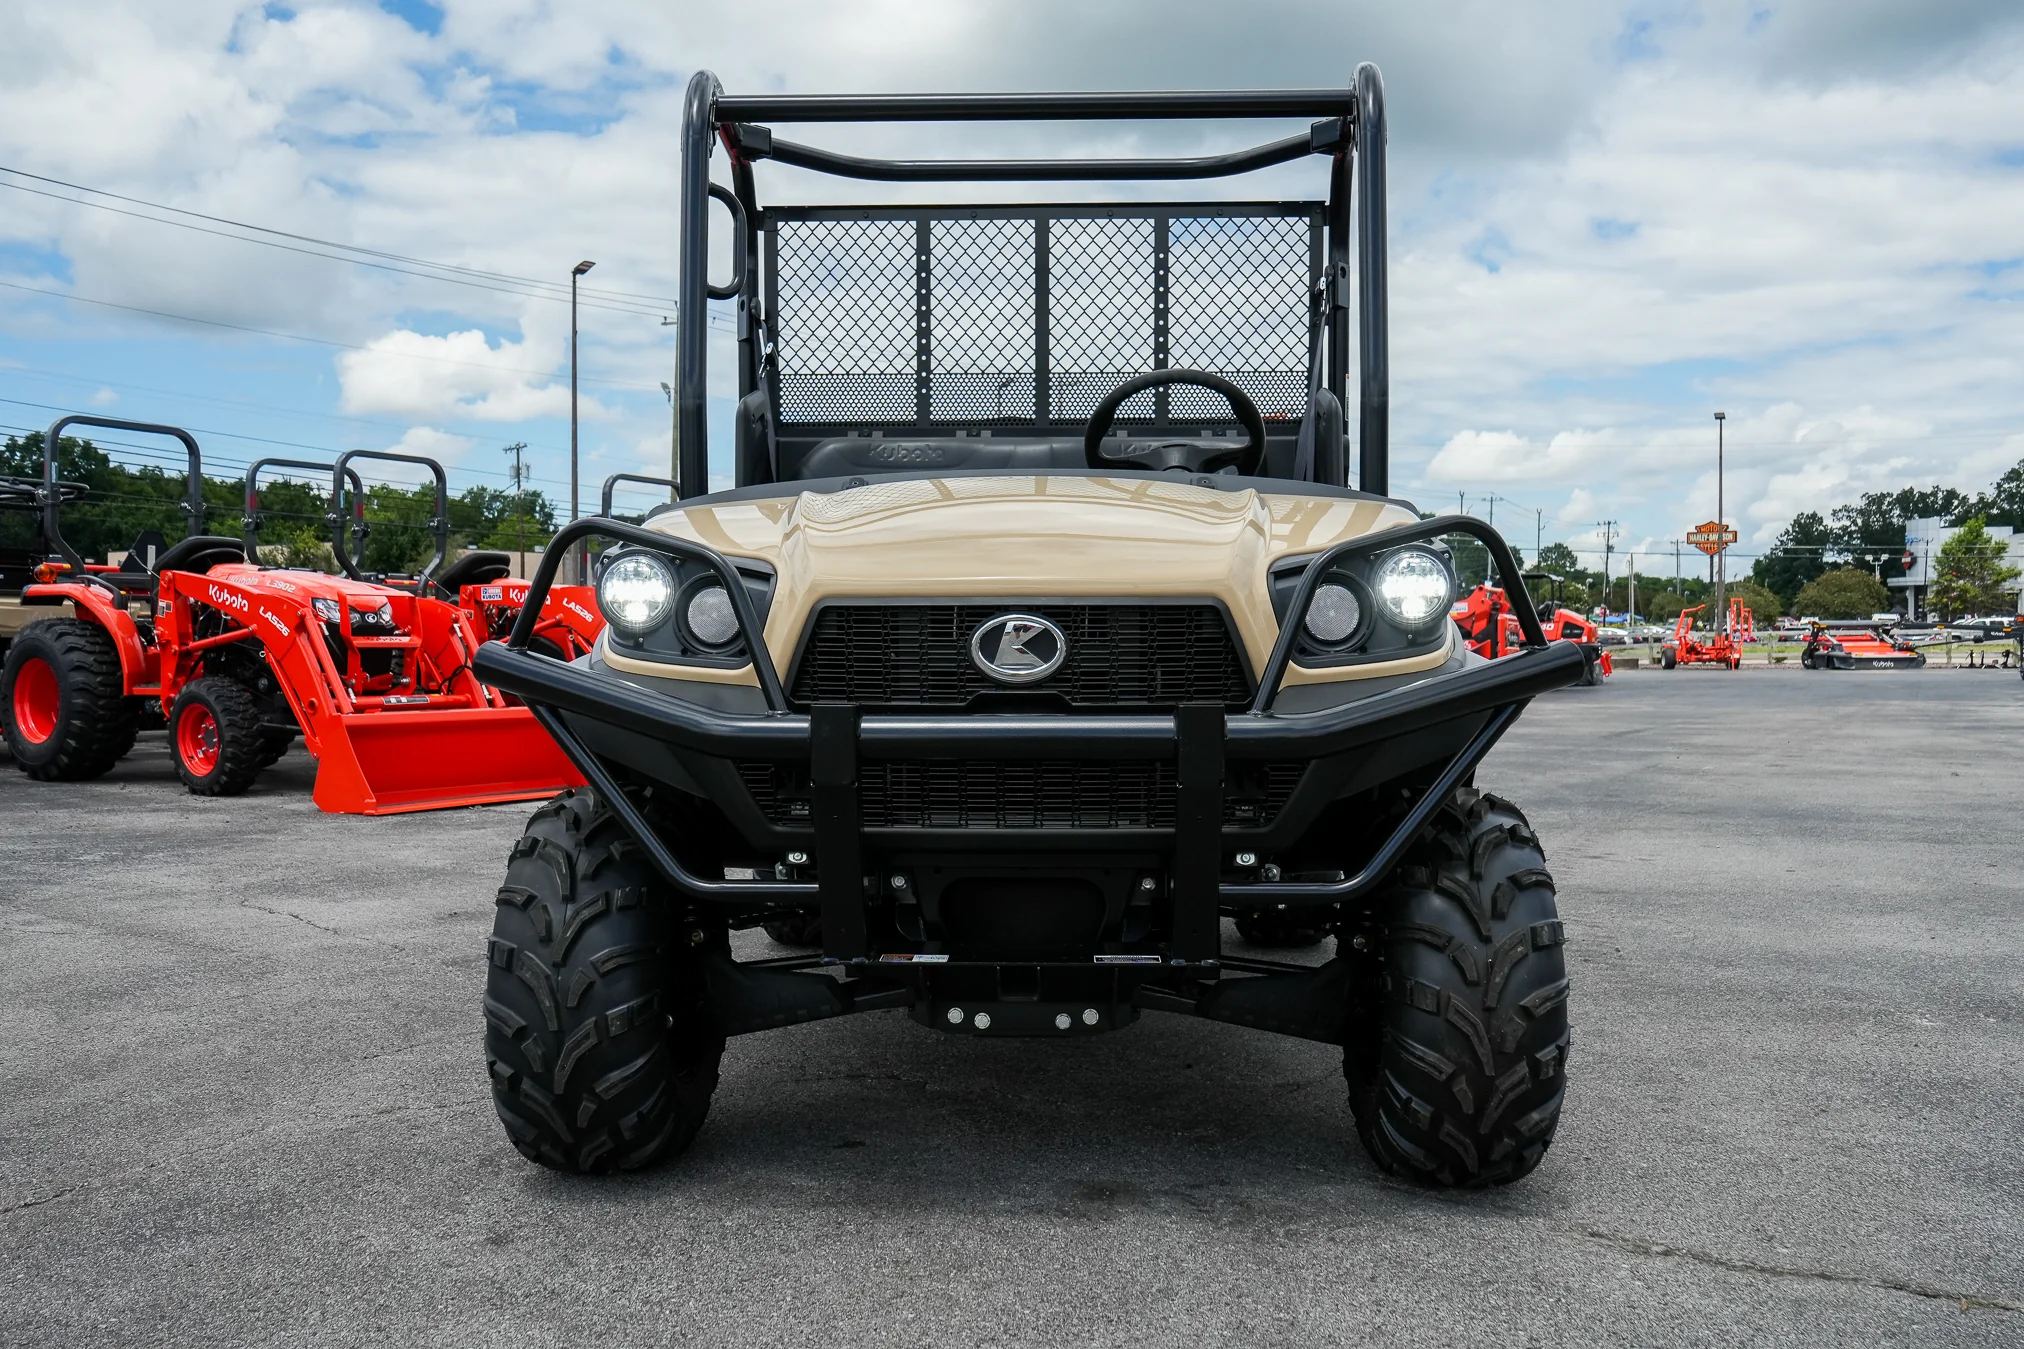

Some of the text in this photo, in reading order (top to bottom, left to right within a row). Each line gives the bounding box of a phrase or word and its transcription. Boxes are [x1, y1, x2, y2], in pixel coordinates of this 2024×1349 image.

[868, 443, 944, 461] Kubota
[265, 579, 296, 593] L3902
[208, 583, 249, 612] Kubota
[562, 598, 594, 622] LA526
[259, 606, 290, 636] LA526
[1872, 660, 1894, 668] Kubota
